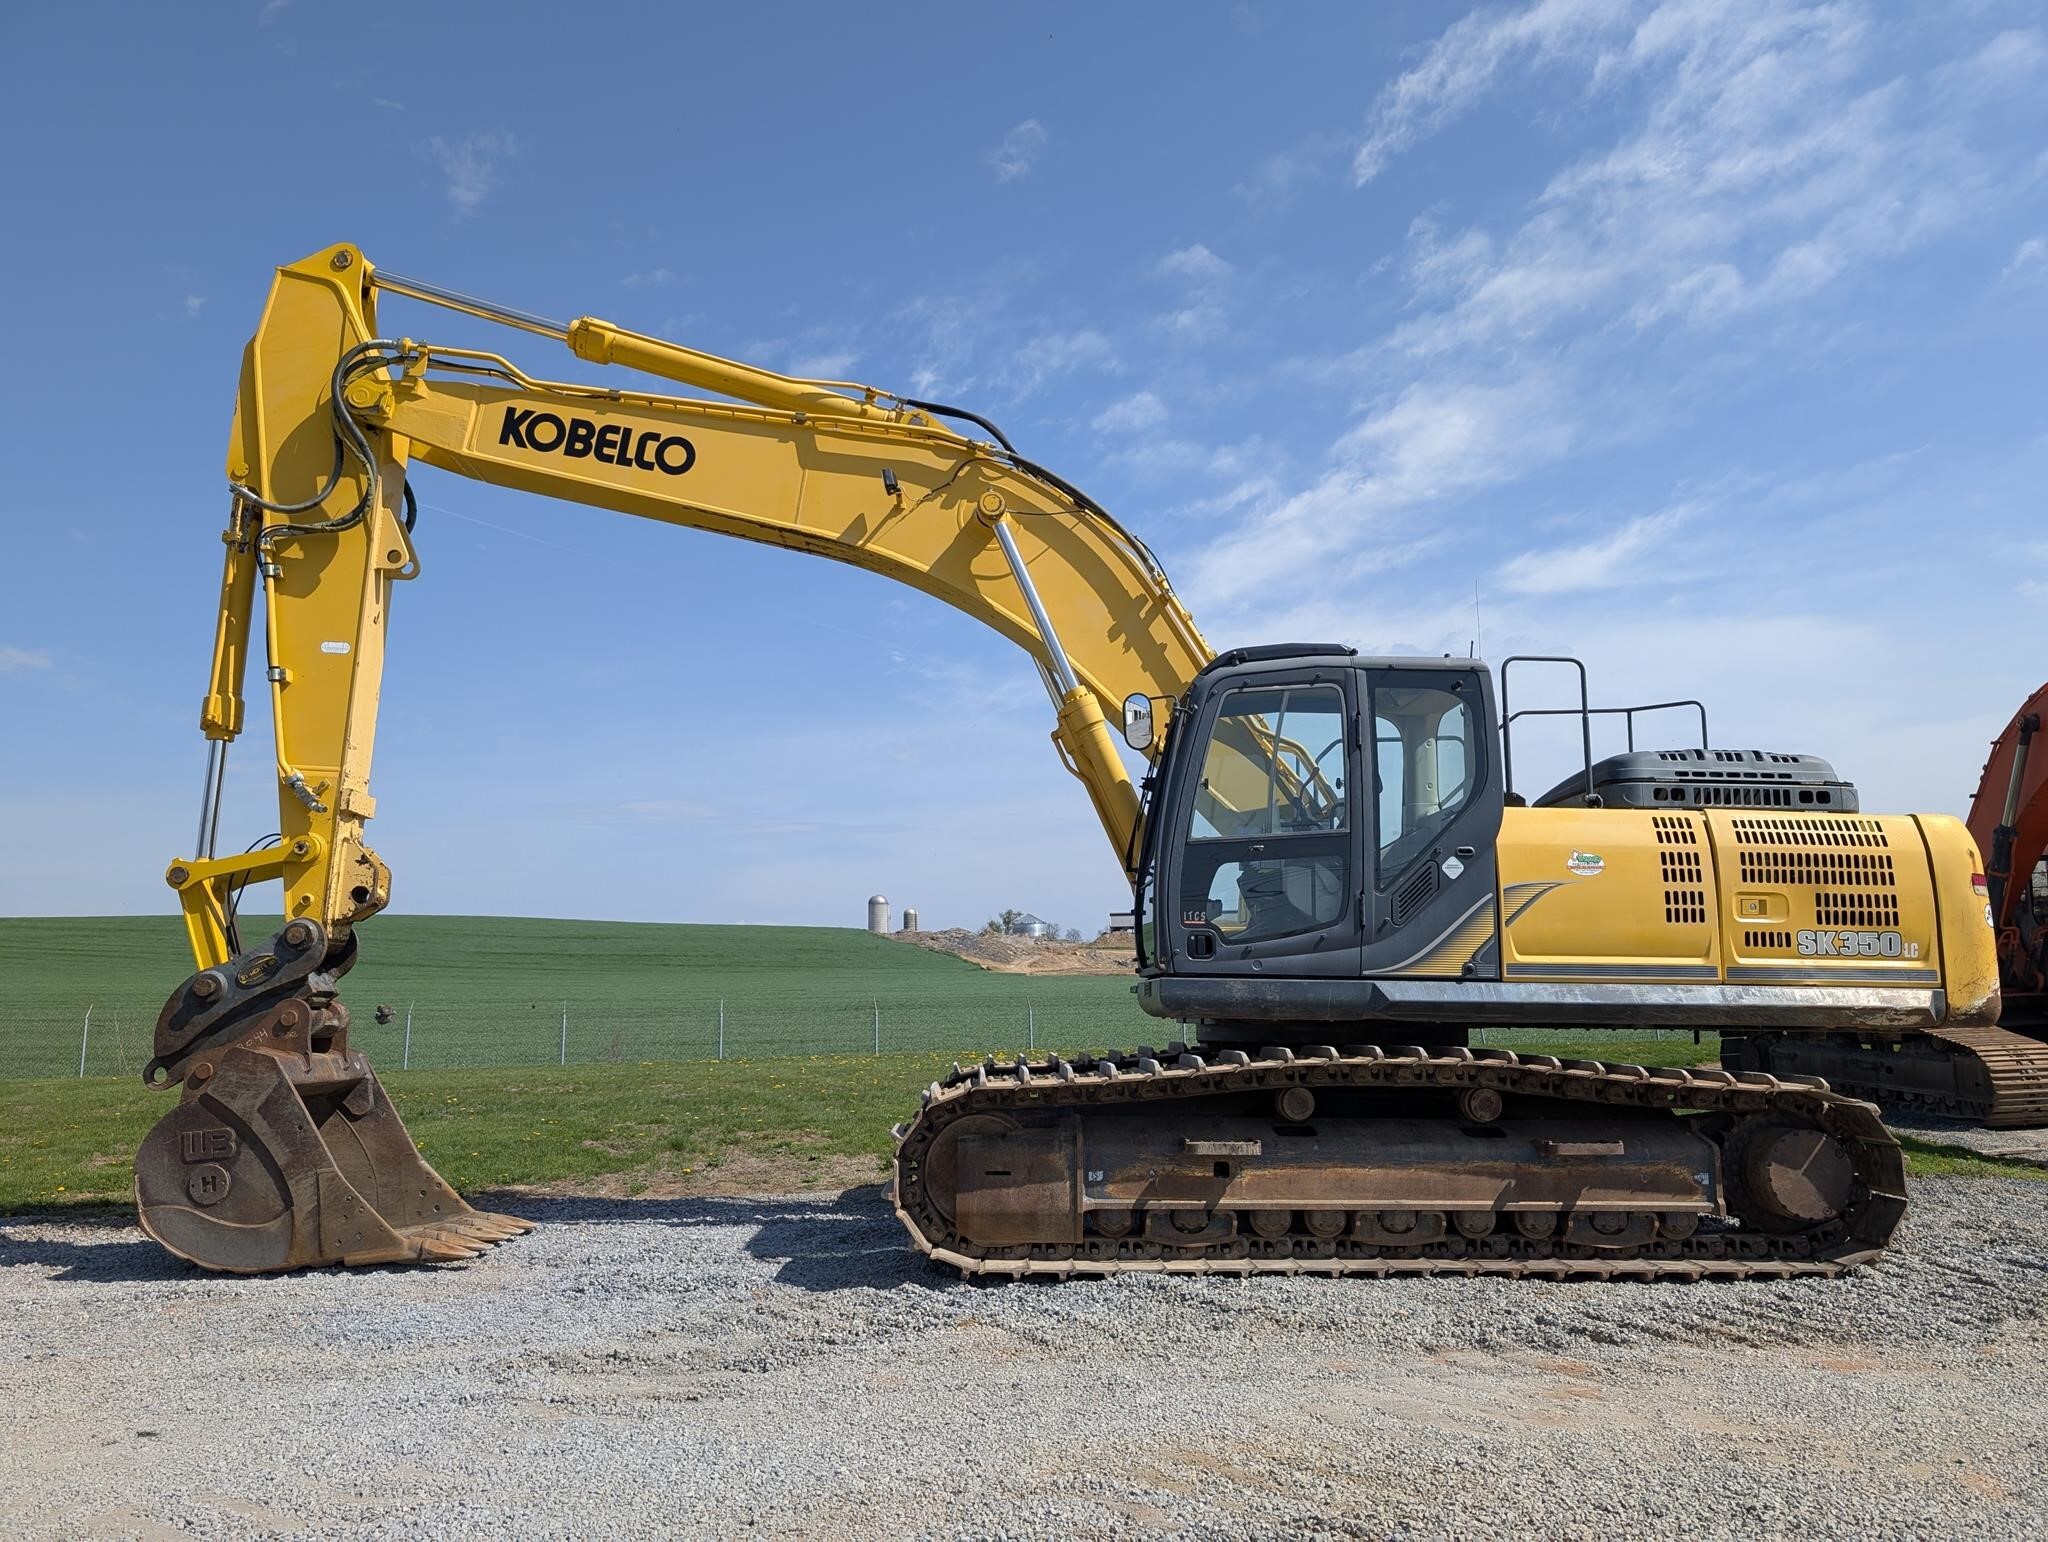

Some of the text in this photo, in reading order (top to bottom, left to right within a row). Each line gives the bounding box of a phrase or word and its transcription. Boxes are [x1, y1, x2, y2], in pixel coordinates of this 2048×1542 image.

[499, 406, 696, 476] KOBELCO
[1797, 930, 1919, 958] SK350 LC
